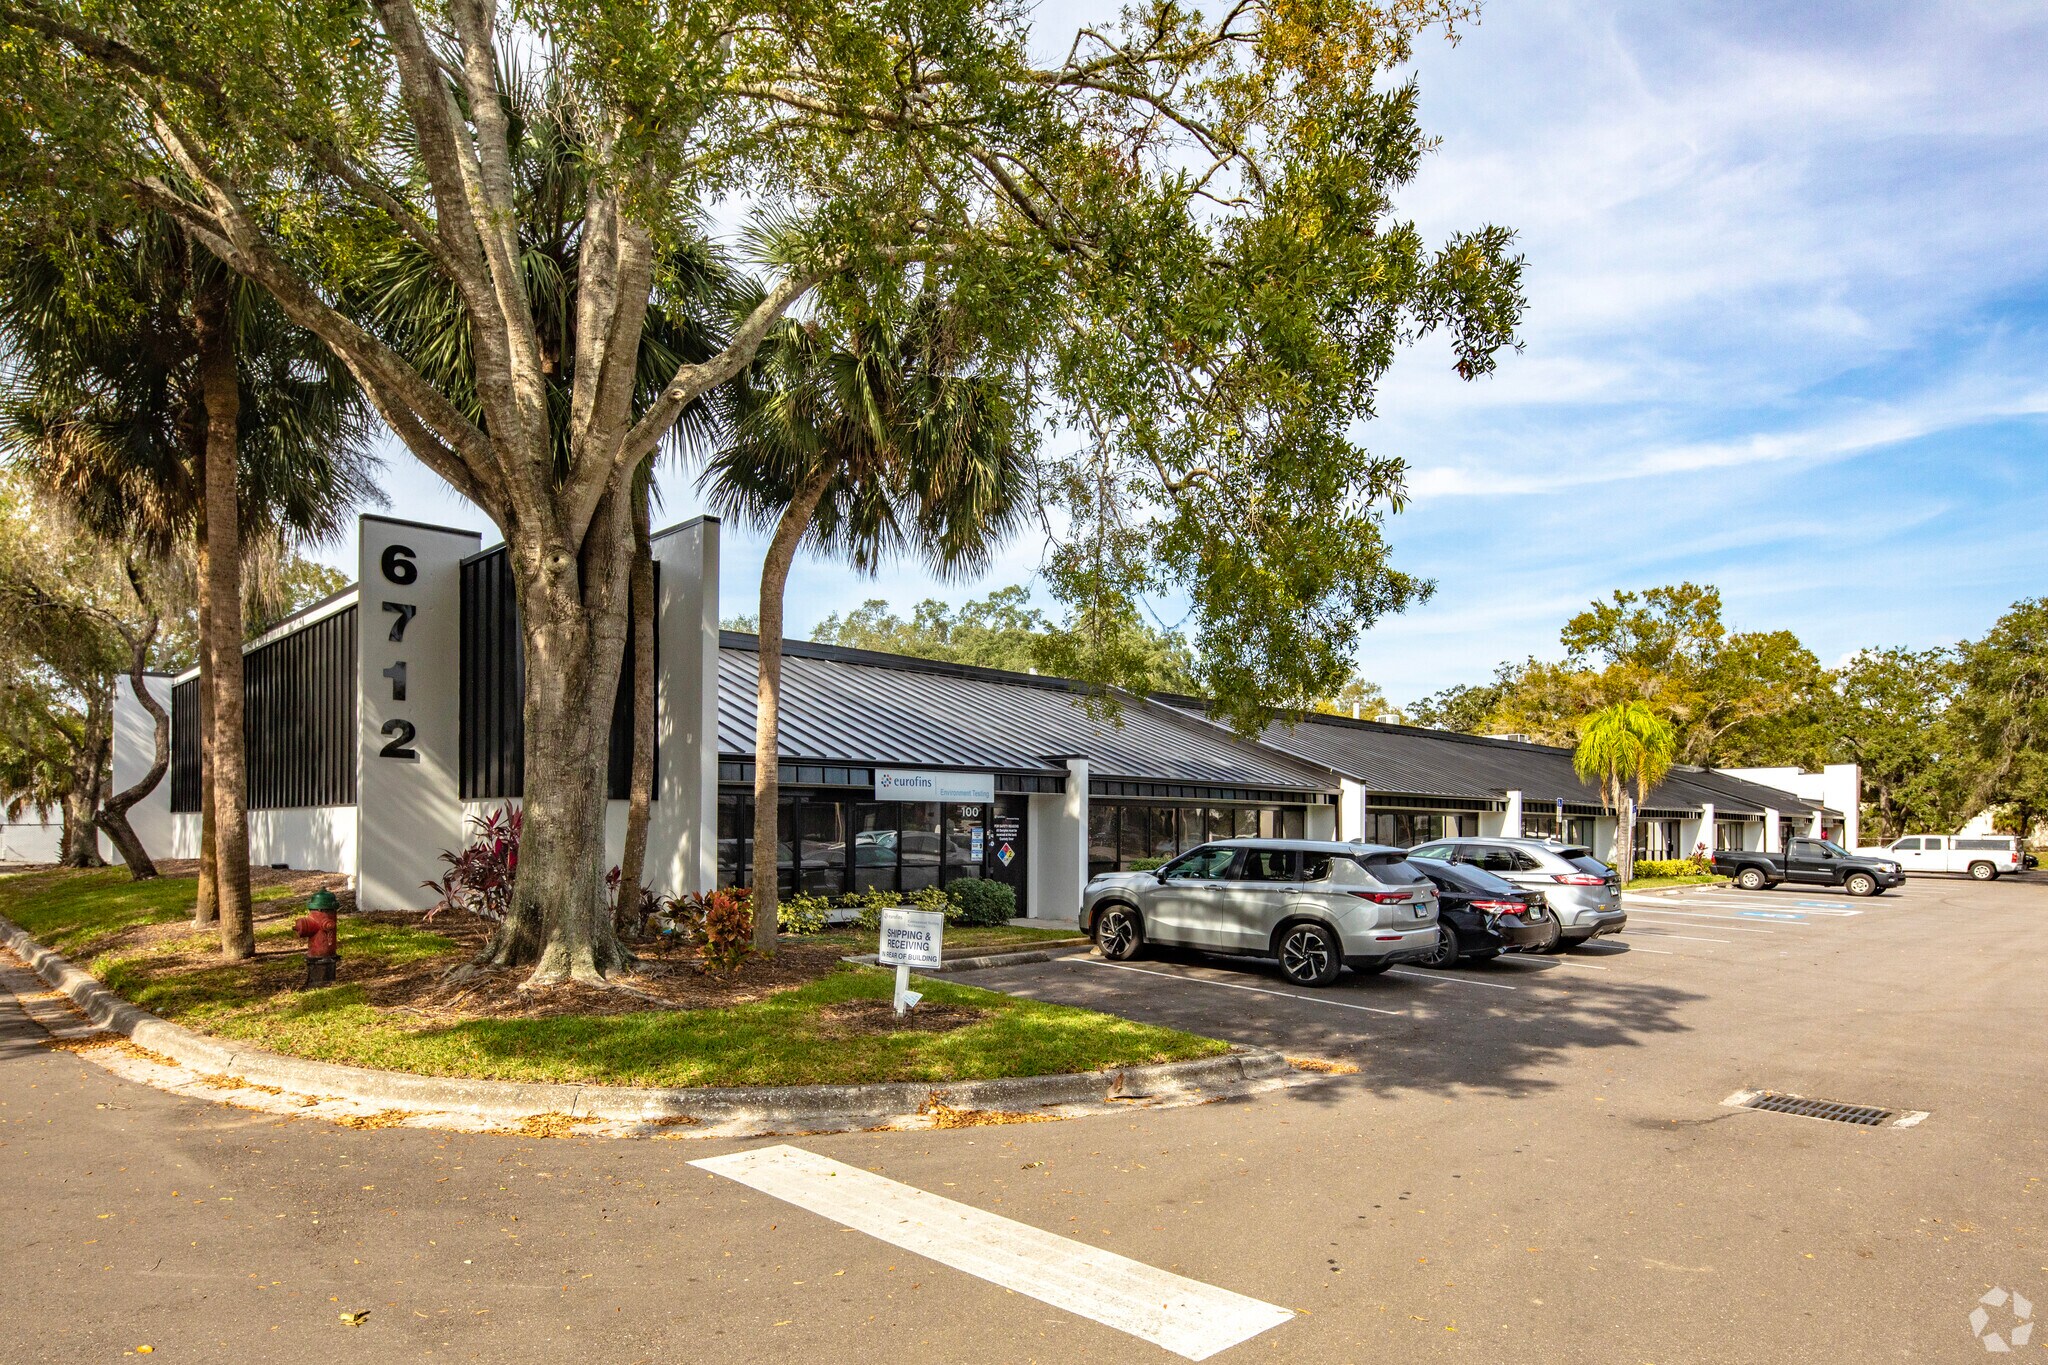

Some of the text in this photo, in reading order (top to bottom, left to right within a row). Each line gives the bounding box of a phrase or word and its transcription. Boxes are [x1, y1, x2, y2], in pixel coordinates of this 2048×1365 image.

[380, 544, 418, 759] 6712
[894, 776, 932, 788] eurofins
[940, 789, 990, 798] Environment Testing
[961, 807, 979, 817] 100
[887, 928, 931, 941] SHIPPING &
[887, 939, 930, 951] RECEIVING
[908, 953, 938, 962] BUILDING
